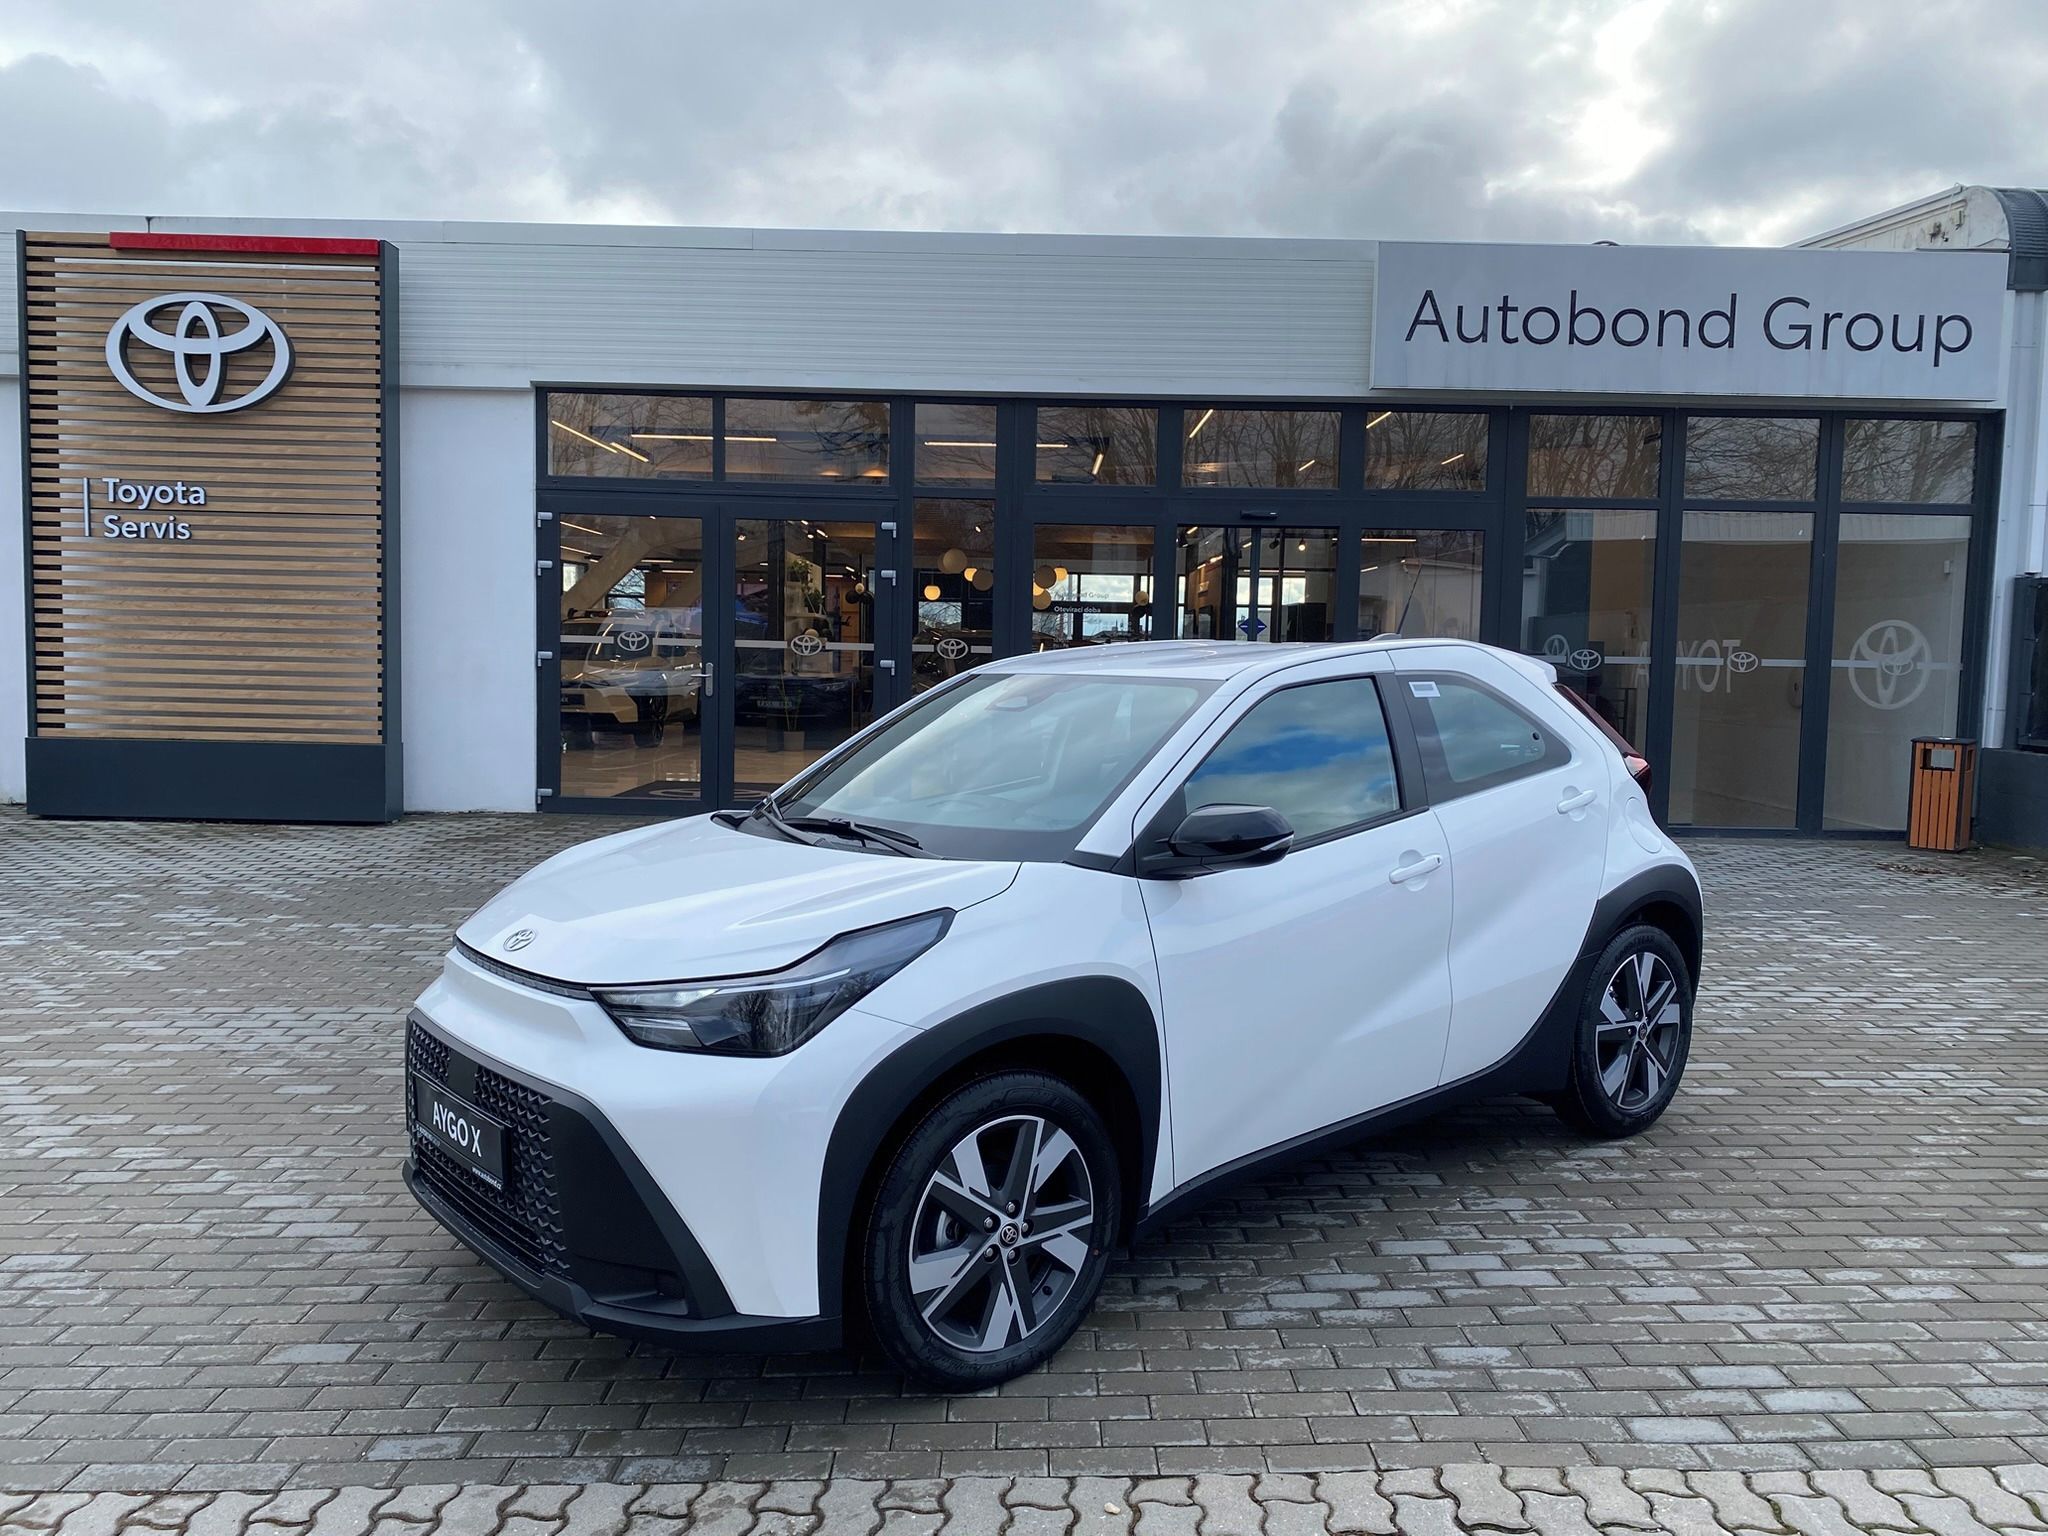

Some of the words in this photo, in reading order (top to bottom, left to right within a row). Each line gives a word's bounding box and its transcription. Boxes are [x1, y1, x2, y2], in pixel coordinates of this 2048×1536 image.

[1404, 289, 1738, 349] Autobond
[1763, 295, 1974, 368] Group
[102, 477, 206, 510] Toyota
[103, 514, 192, 540] Servis
[1083, 605, 1101, 613] doba
[433, 1101, 469, 1147] AYGO
[471, 1125, 482, 1158] X
